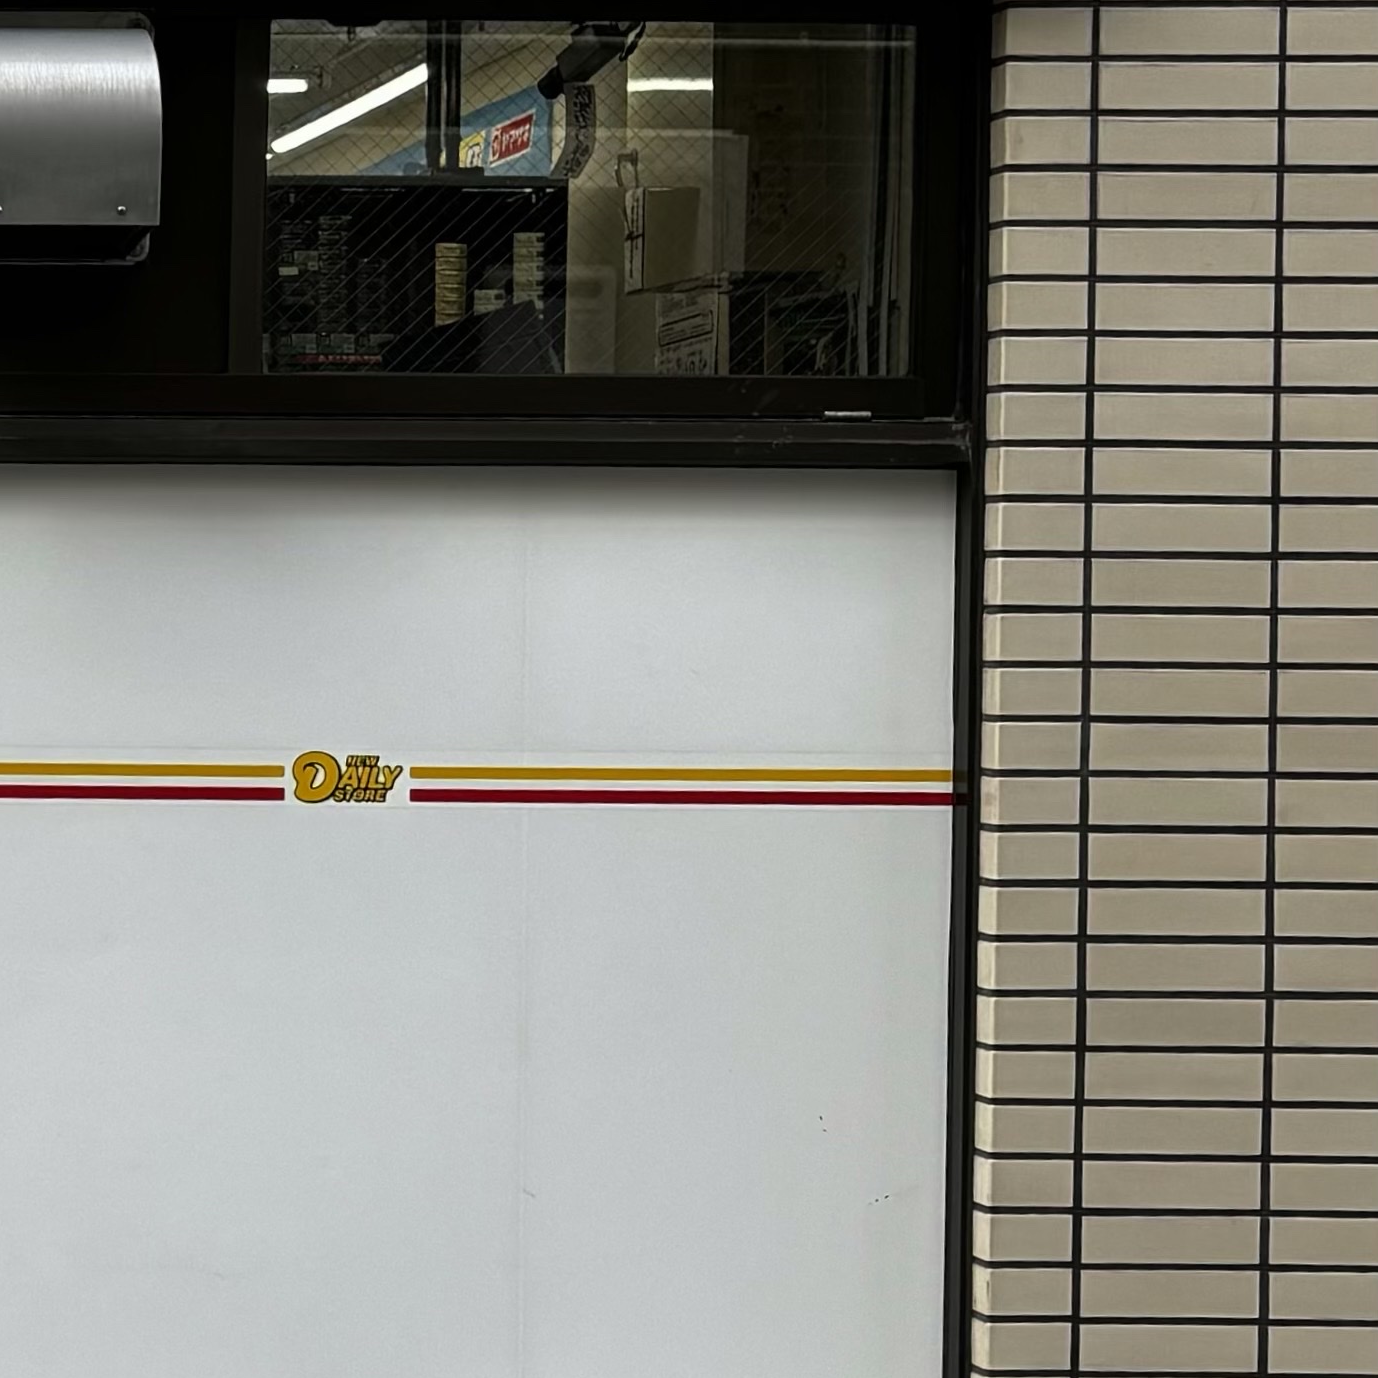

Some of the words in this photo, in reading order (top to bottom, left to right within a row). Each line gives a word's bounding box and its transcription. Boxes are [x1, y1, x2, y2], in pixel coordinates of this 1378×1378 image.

[346, 755, 380, 767] NEW
[292, 750, 403, 803] DAILY
[333, 788, 386, 802] STORE
